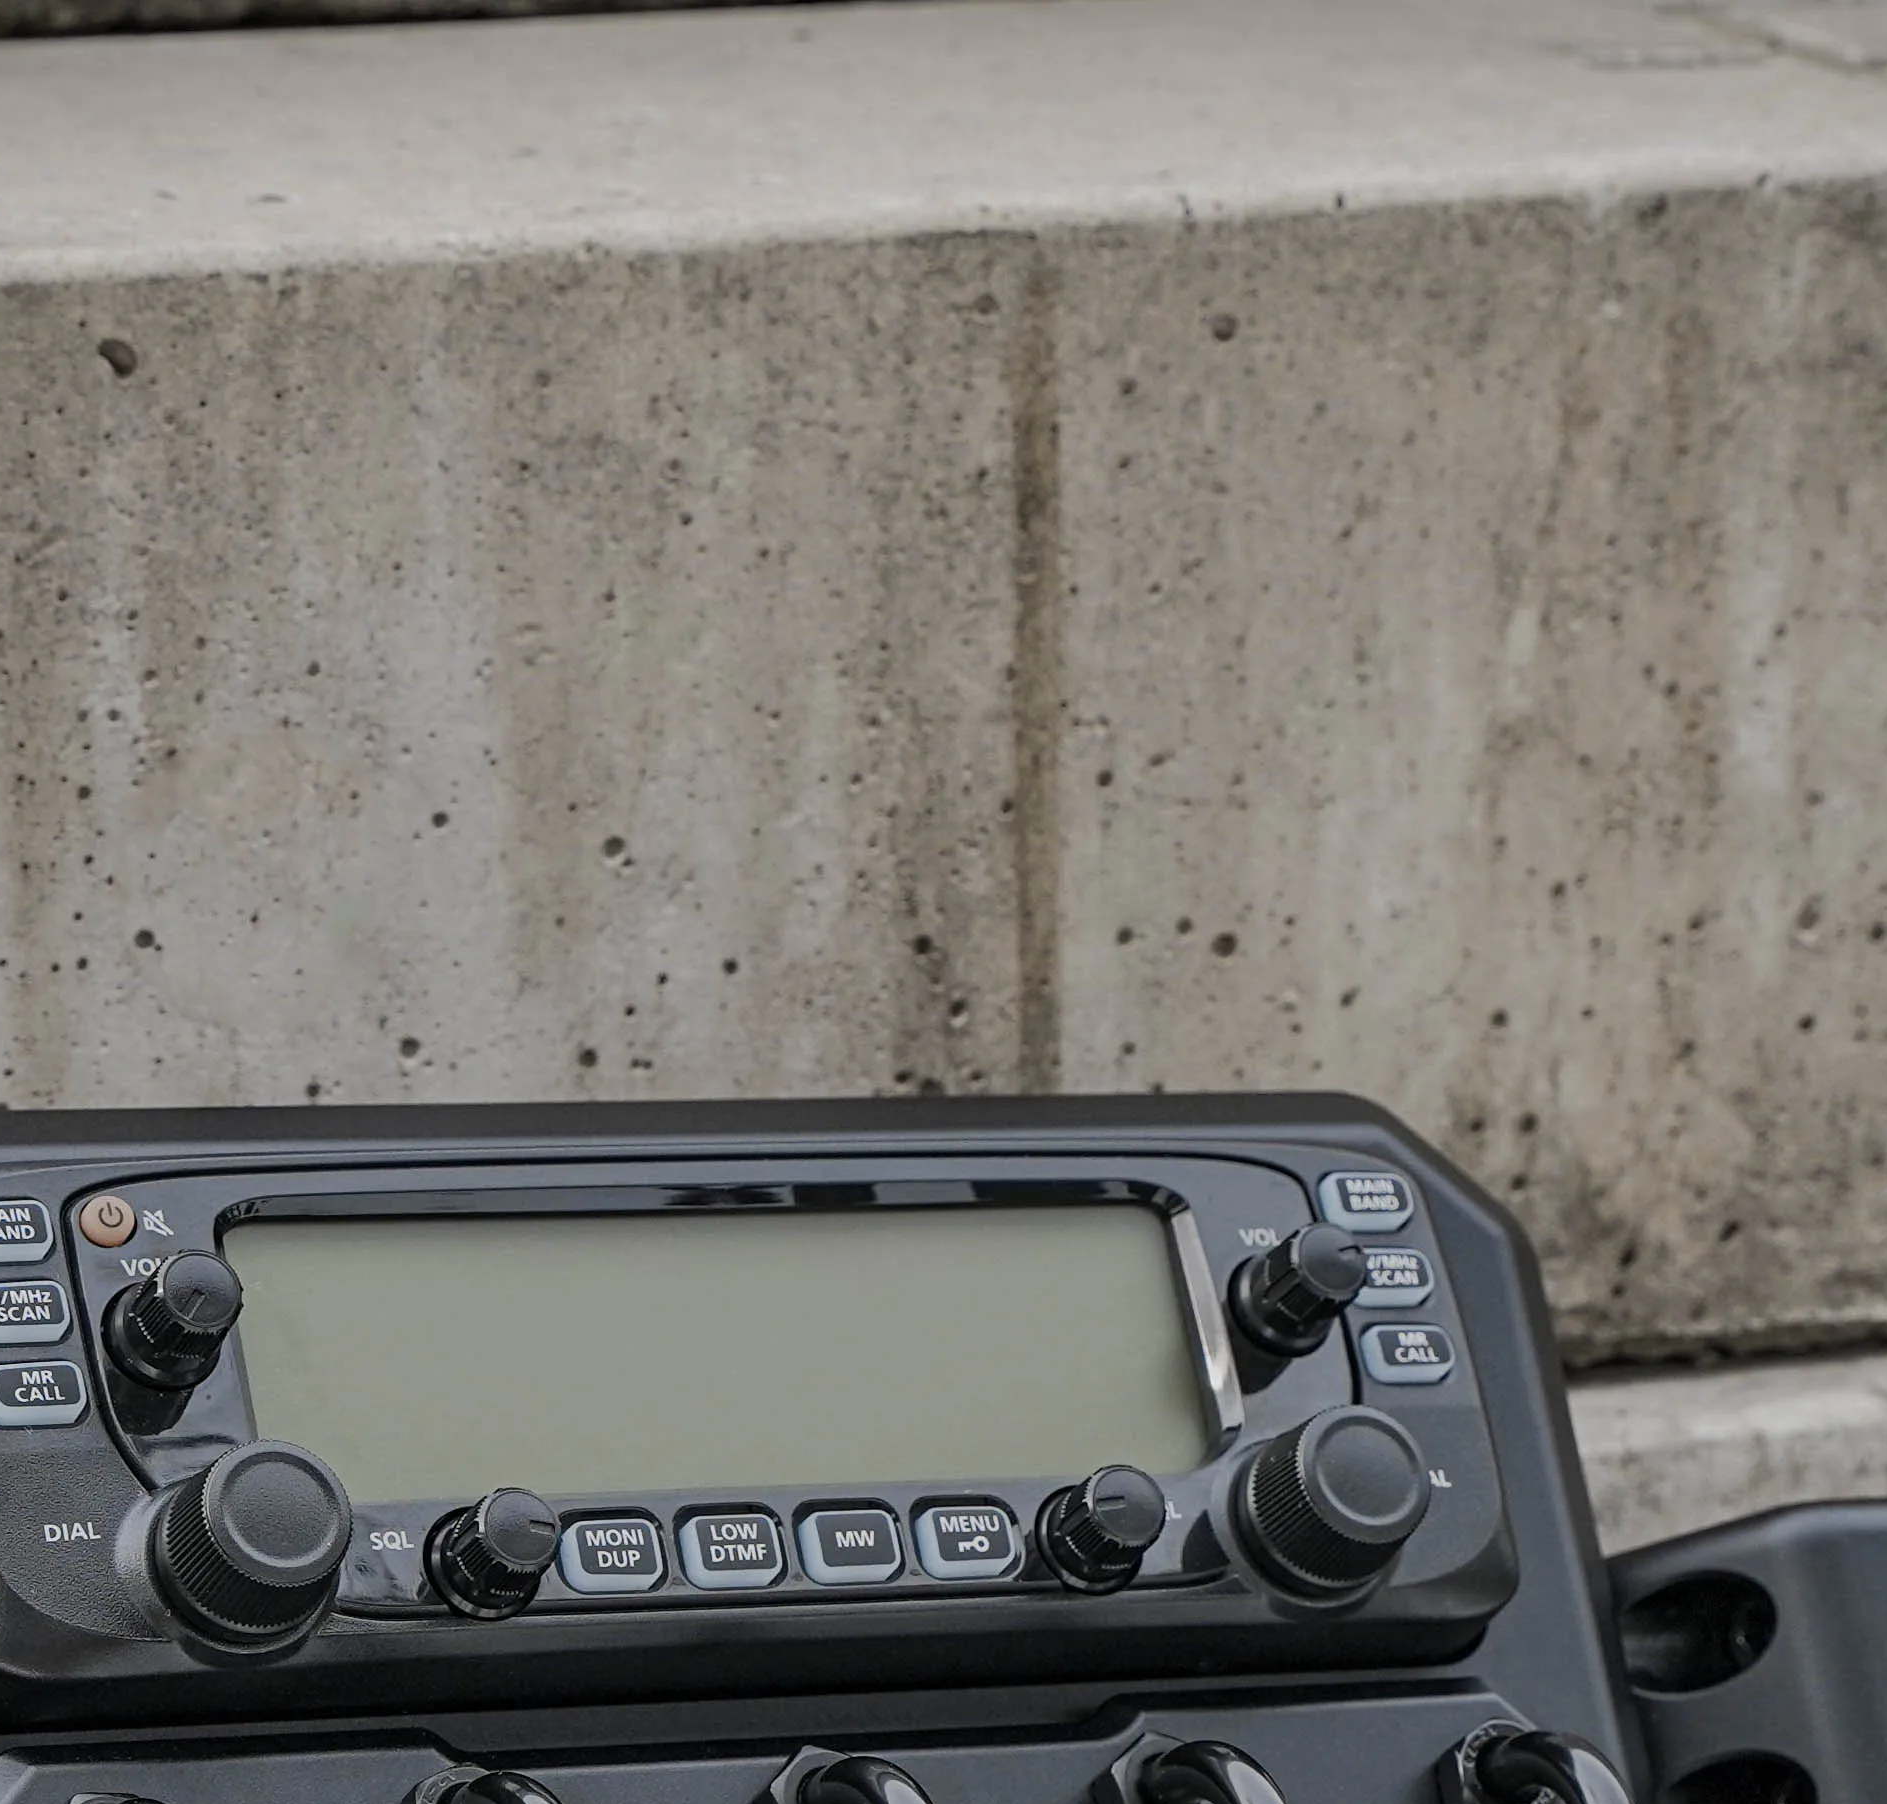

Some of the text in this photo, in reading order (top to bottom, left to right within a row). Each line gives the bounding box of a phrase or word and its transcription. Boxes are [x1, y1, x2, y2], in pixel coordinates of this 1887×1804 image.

[1345, 1178, 1395, 1194] MAIN
[1349, 1194, 1400, 1211] BAND
[1370, 1270, 1420, 1287] SCAN
[1397, 1331, 1429, 1347] MR
[1394, 1346, 1440, 1364] CALL
[21, 1369, 56, 1386] MR
[14, 1385, 66, 1403] CALL
[43, 1521, 102, 1543] DIAL
[710, 1522, 759, 1542] LOW
[939, 1514, 1000, 1534] MENU
[369, 1530, 415, 1552] SQL
[585, 1528, 646, 1549] MONI
[834, 1529, 876, 1549] MW
[597, 1548, 642, 1569] DUP
[709, 1542, 768, 1563] DTMF
